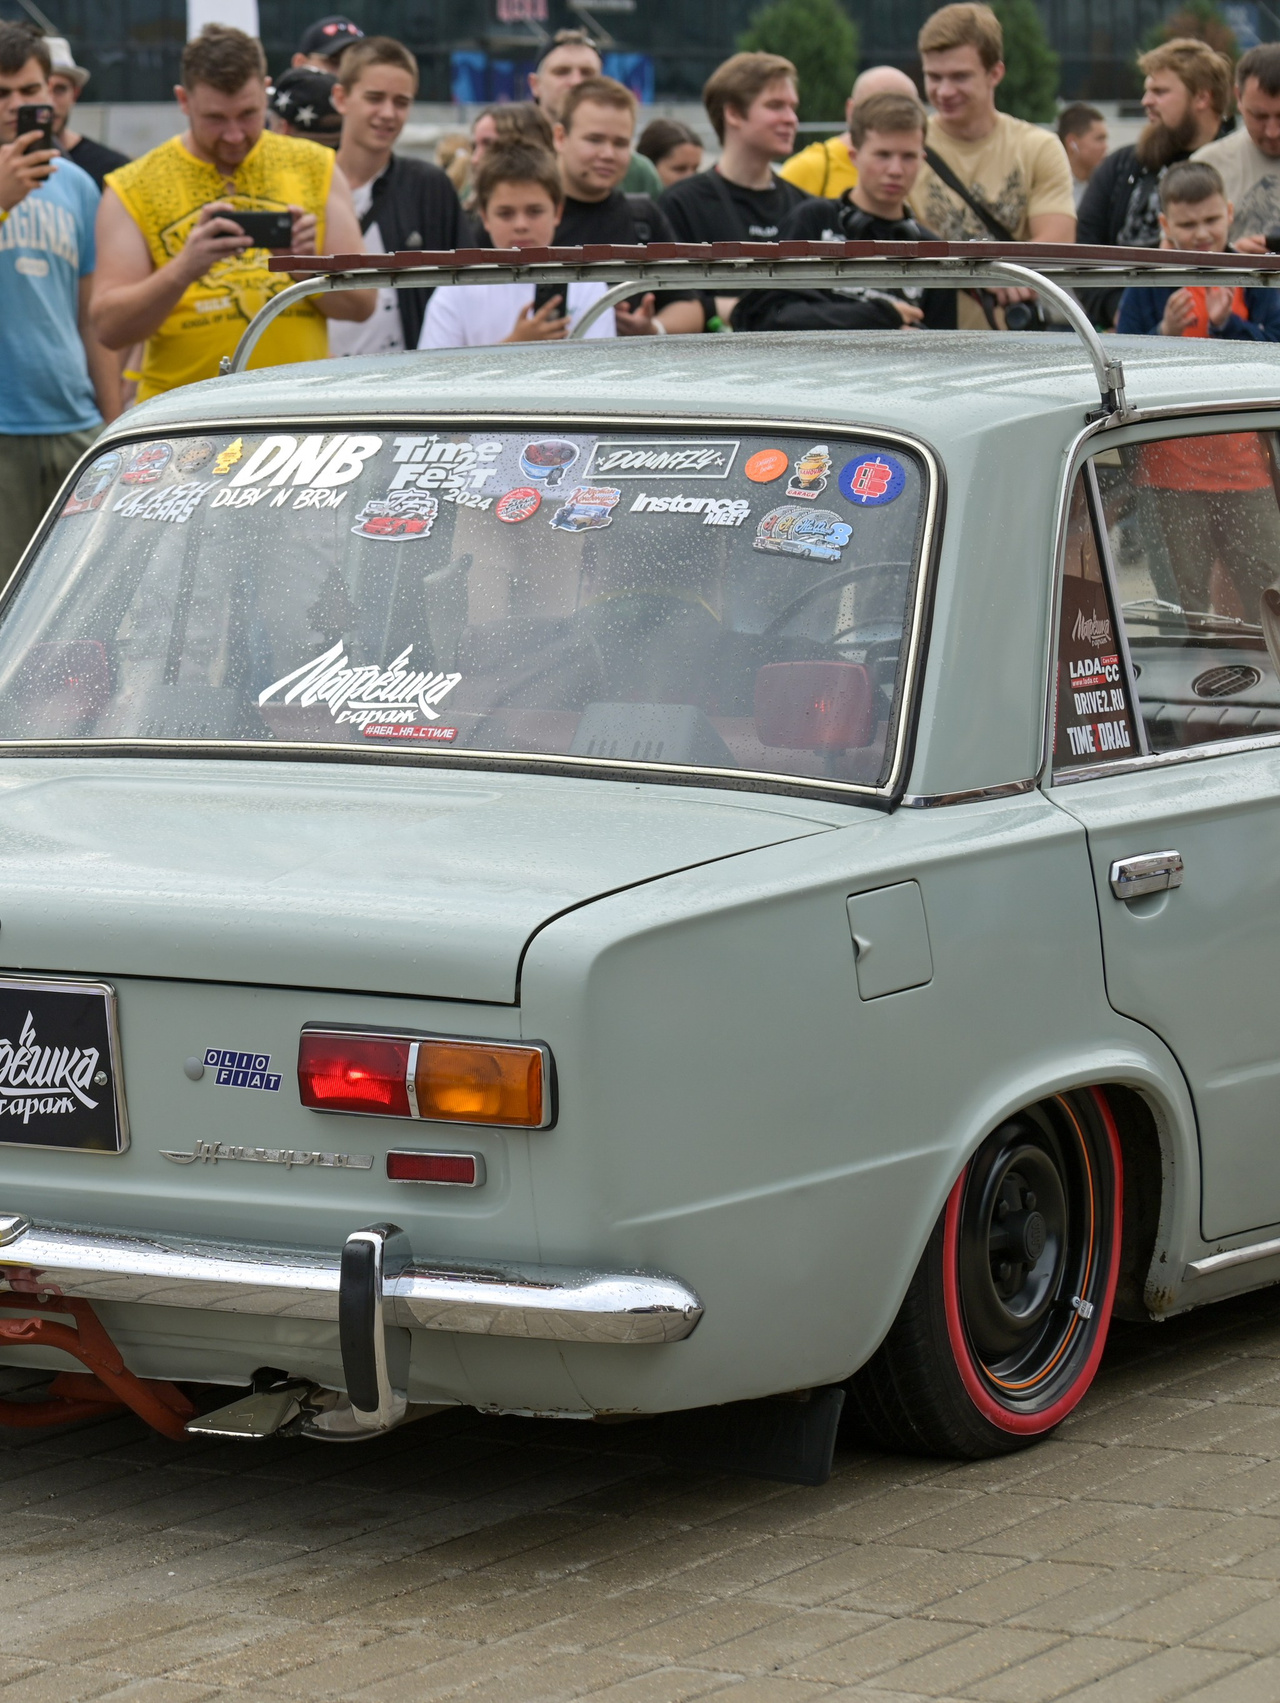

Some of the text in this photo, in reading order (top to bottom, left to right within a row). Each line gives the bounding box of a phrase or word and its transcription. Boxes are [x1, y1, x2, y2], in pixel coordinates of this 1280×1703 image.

[228, 434, 383, 488] DNB
[392, 435, 503, 463] Time
[387, 463, 498, 491] Fest
[112, 479, 223, 512] CLASH
[269, 487, 295, 508] N
[291, 488, 348, 510] BRM
[443, 488, 494, 511] 2024
[629, 492, 750, 514] Instance
[703, 508, 751, 526] MEET
[258, 639, 463, 721] Матрёшка
[1073, 688, 1126, 716] DRIVE2.RU
[334, 708, 420, 732] гараж
[207, 1051, 267, 1071] OLIO
[219, 1069, 280, 1089] FIAT
